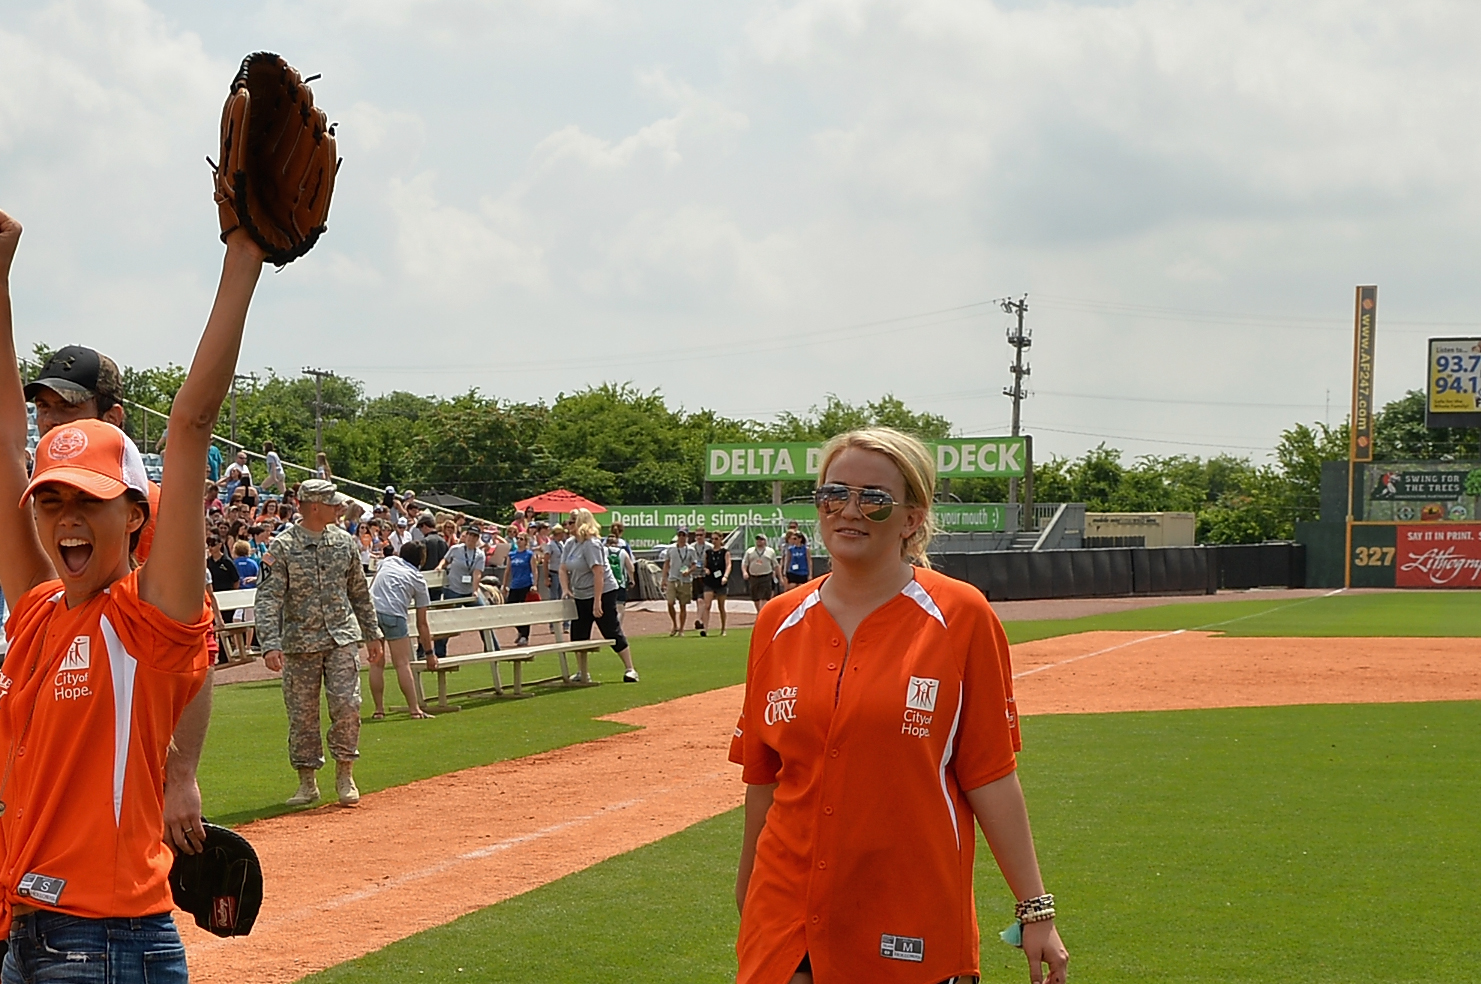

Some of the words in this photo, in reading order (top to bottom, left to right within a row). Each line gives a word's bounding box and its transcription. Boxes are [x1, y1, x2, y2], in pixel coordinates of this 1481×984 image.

[1358, 314, 1371, 430] www.AF247.com
[1436, 355, 1481, 373] 93.7
[1435, 376, 1477, 394] 94.1
[710, 447, 795, 476] DELTA
[936, 443, 1021, 472] DECK
[1405, 475, 1438, 483] SWING
[1441, 475, 1460, 483] FOR
[1405, 484, 1424, 492] THE
[1428, 484, 1460, 492] TREES
[611, 509, 659, 527] Dental
[664, 509, 706, 527] made
[711, 509, 762, 529] simple
[941, 512, 961, 529] your
[961, 508, 988, 525] mouth
[1407, 531, 1423, 541] SAY
[1424, 531, 1432, 541] IT
[1434, 531, 1445, 541] IN
[1446, 531, 1474, 541] PRINT.
[1354, 546, 1396, 566] 327
[54, 672, 78, 686] City
[782, 686, 798, 699] OLE
[903, 709, 925, 725] City
[40, 881, 51, 891] S
[902, 942, 913, 952] M
